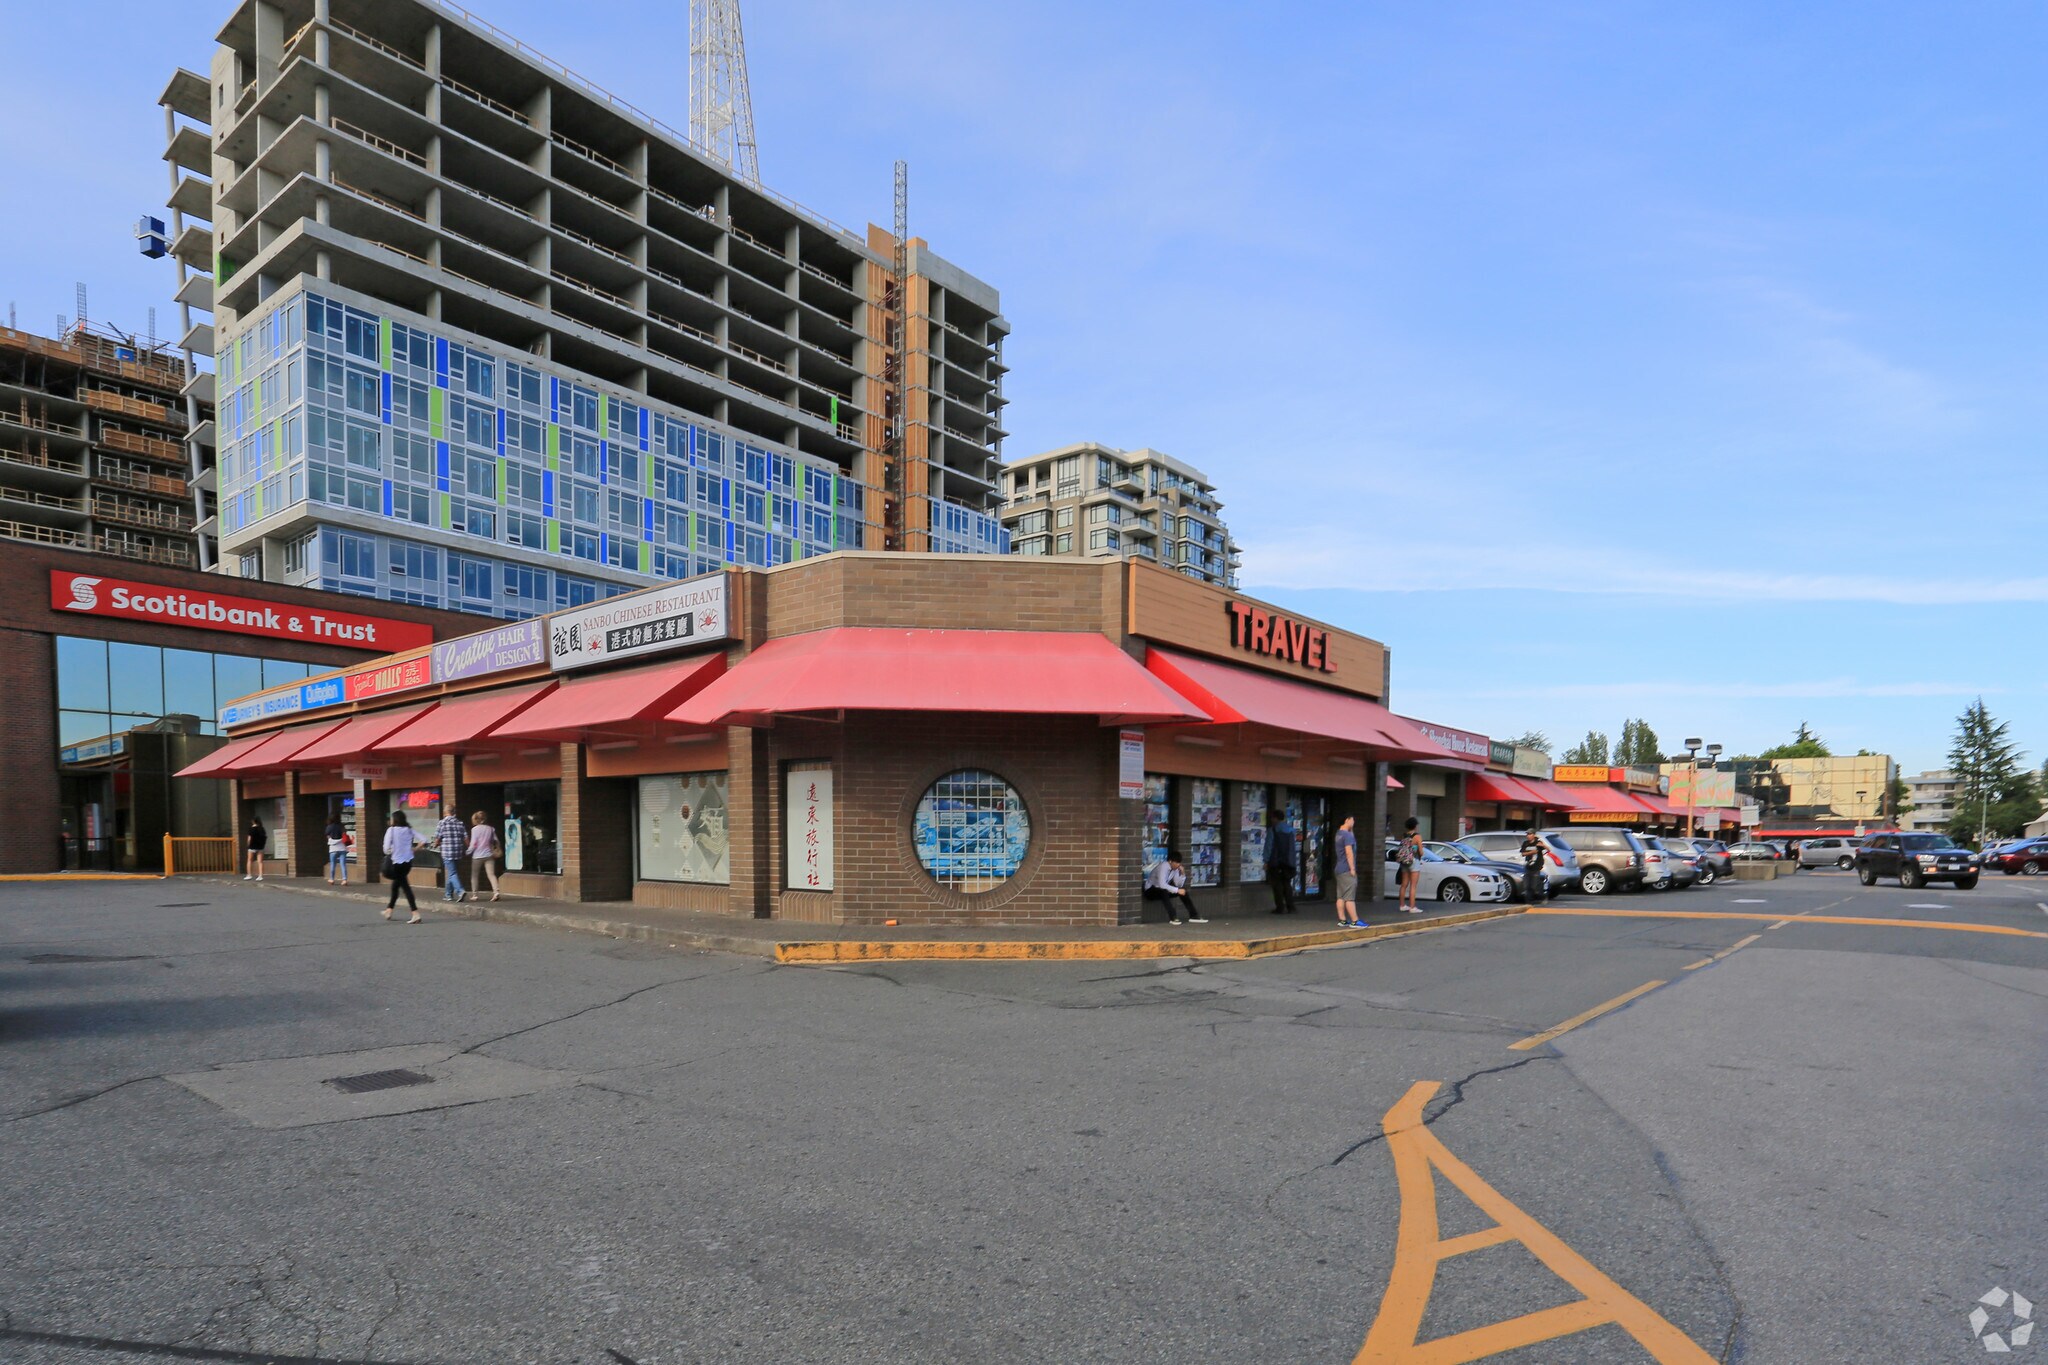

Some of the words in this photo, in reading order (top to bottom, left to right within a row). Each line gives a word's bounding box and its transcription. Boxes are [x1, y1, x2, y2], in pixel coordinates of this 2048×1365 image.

[111, 587, 281, 630] Scotiabank
[287, 617, 304, 633] &
[310, 615, 376, 643] Trust
[583, 614, 612, 632] SANBO
[613, 603, 653, 625] CHINESE
[655, 586, 722, 615] RESTAURANT
[444, 634, 497, 679] Creative
[498, 627, 526, 648] HAIR
[495, 643, 533, 667] DESIGN
[1228, 601, 1337, 673] TRAVEL
[375, 666, 403, 692] NAILS
[263, 694, 299, 715] INSURANCE
[806, 782, 820, 887] 遠東旅行社
